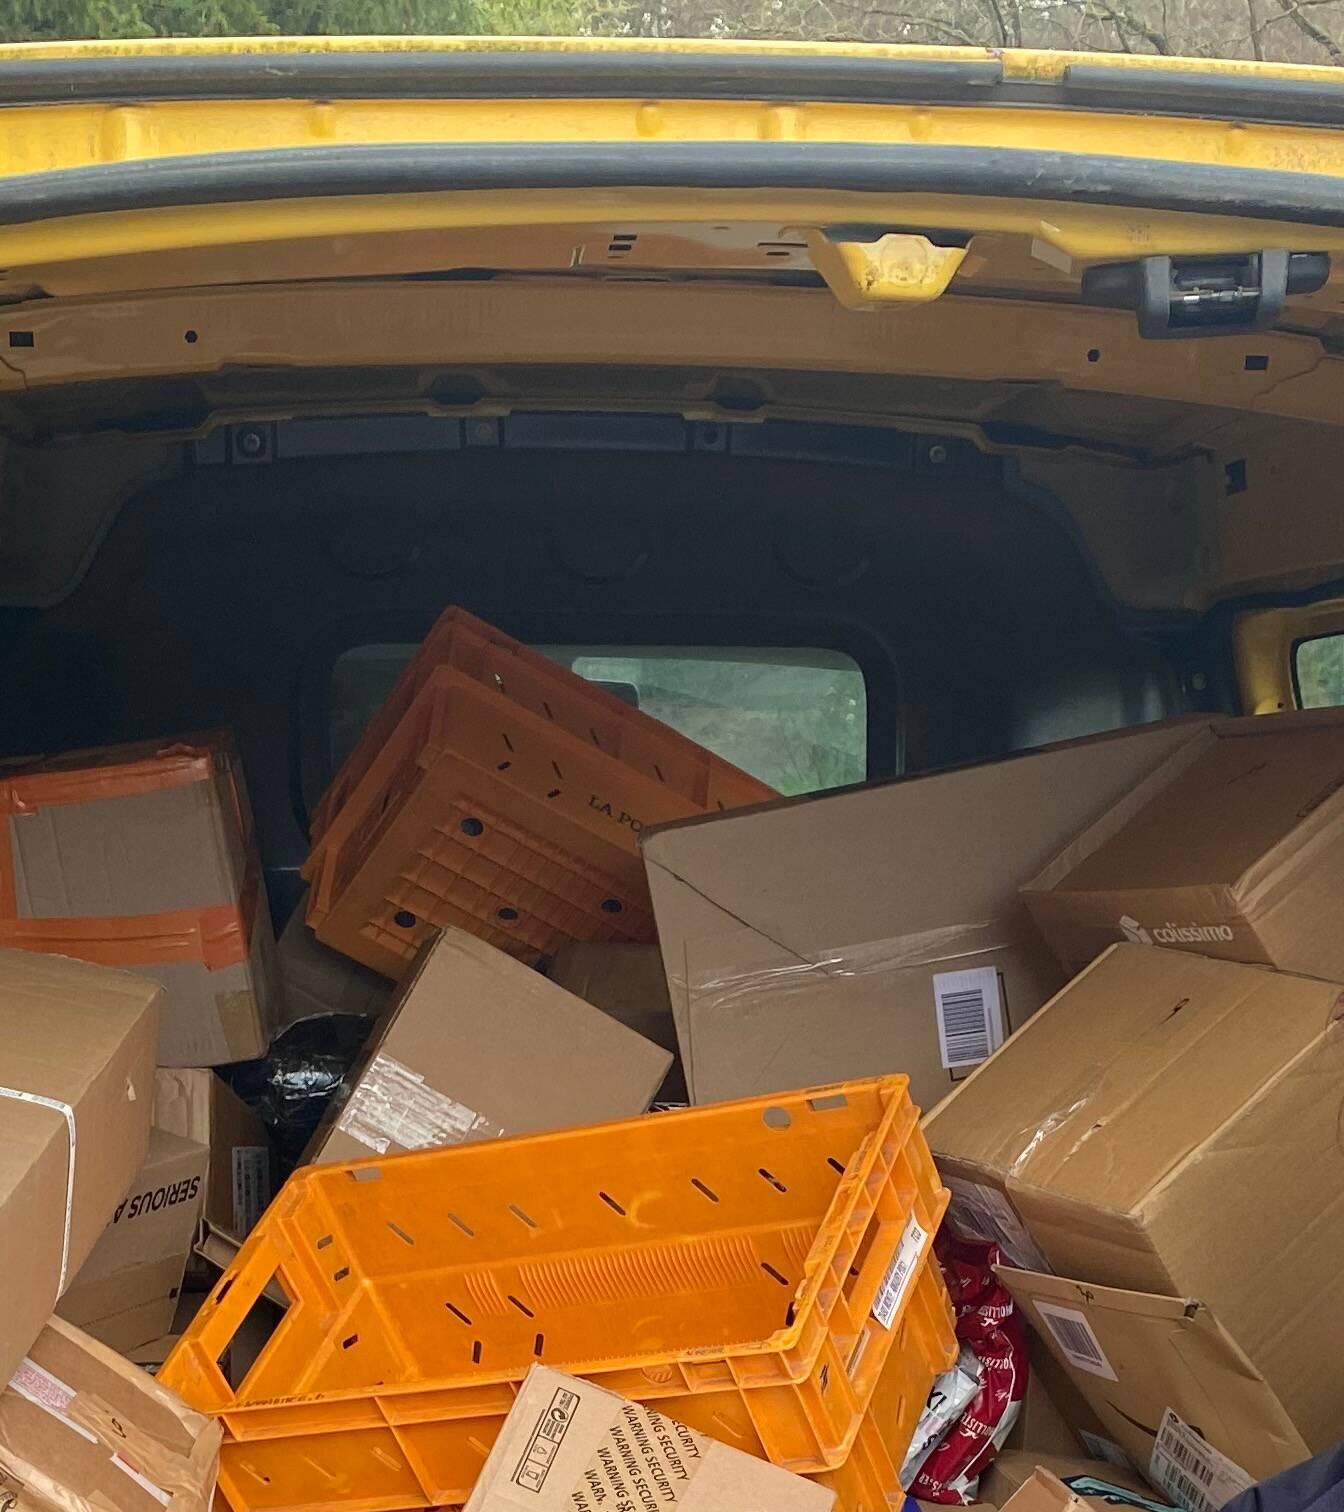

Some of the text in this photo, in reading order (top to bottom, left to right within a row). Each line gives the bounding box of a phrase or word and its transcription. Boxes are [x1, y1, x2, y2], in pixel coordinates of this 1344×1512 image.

[589, 794, 614, 818] LA
[1153, 922, 1234, 943] colissimo
[127, 1176, 201, 1219] SERIOUS
[597, 1447, 630, 1498] WARNING
[609, 1425, 642, 1476] WARNING
[622, 1404, 678, 1503] WARNING SECURITY
[656, 1434, 690, 1481] SECURITY
